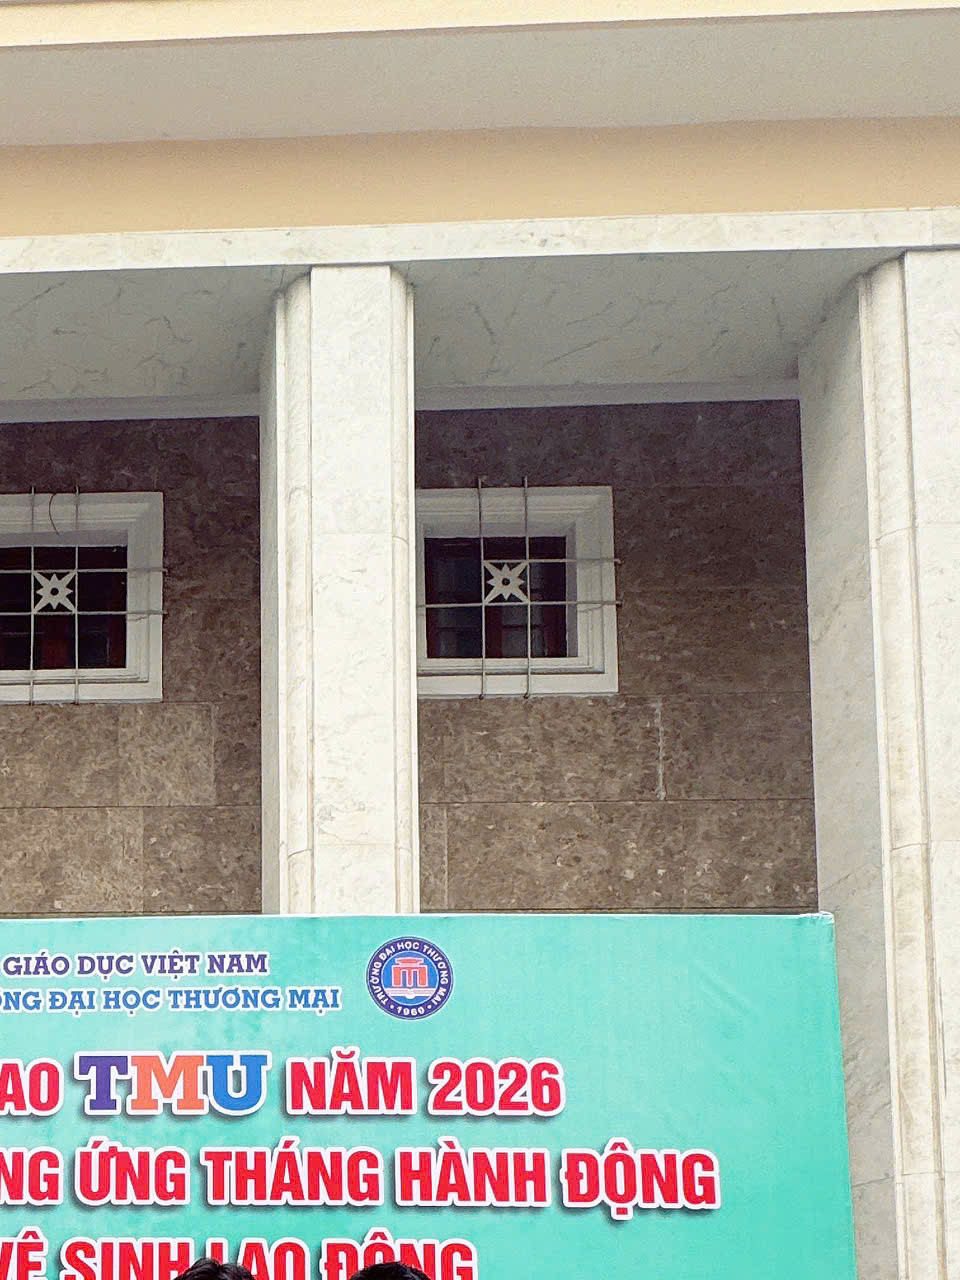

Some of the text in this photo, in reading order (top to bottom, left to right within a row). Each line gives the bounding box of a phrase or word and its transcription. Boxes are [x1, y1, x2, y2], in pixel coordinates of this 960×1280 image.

[396, 940, 420, 952] HỌC
[3, 951, 70, 976] GIÁO
[77, 955, 134, 980] DỤC
[141, 950, 200, 980] VIỆT
[207, 953, 268, 974] NAM
[49, 990, 95, 1015] ĐẠI
[102, 989, 161, 1015] HỌC
[168, 987, 282, 1010] THƯƠNG
[288, 989, 340, 1014] MẠI
[396, 1005, 425, 1016] 1960
[79, 1054, 268, 1112] TMU
[290, 1051, 413, 1111] NĂM
[432, 1061, 561, 1112] 2026
[79, 1141, 186, 1201] ỨNG
[204, 1139, 379, 1202] THÁNG
[399, 1140, 547, 1203] HÀNH
[563, 1141, 716, 1215] ĐỘNG
